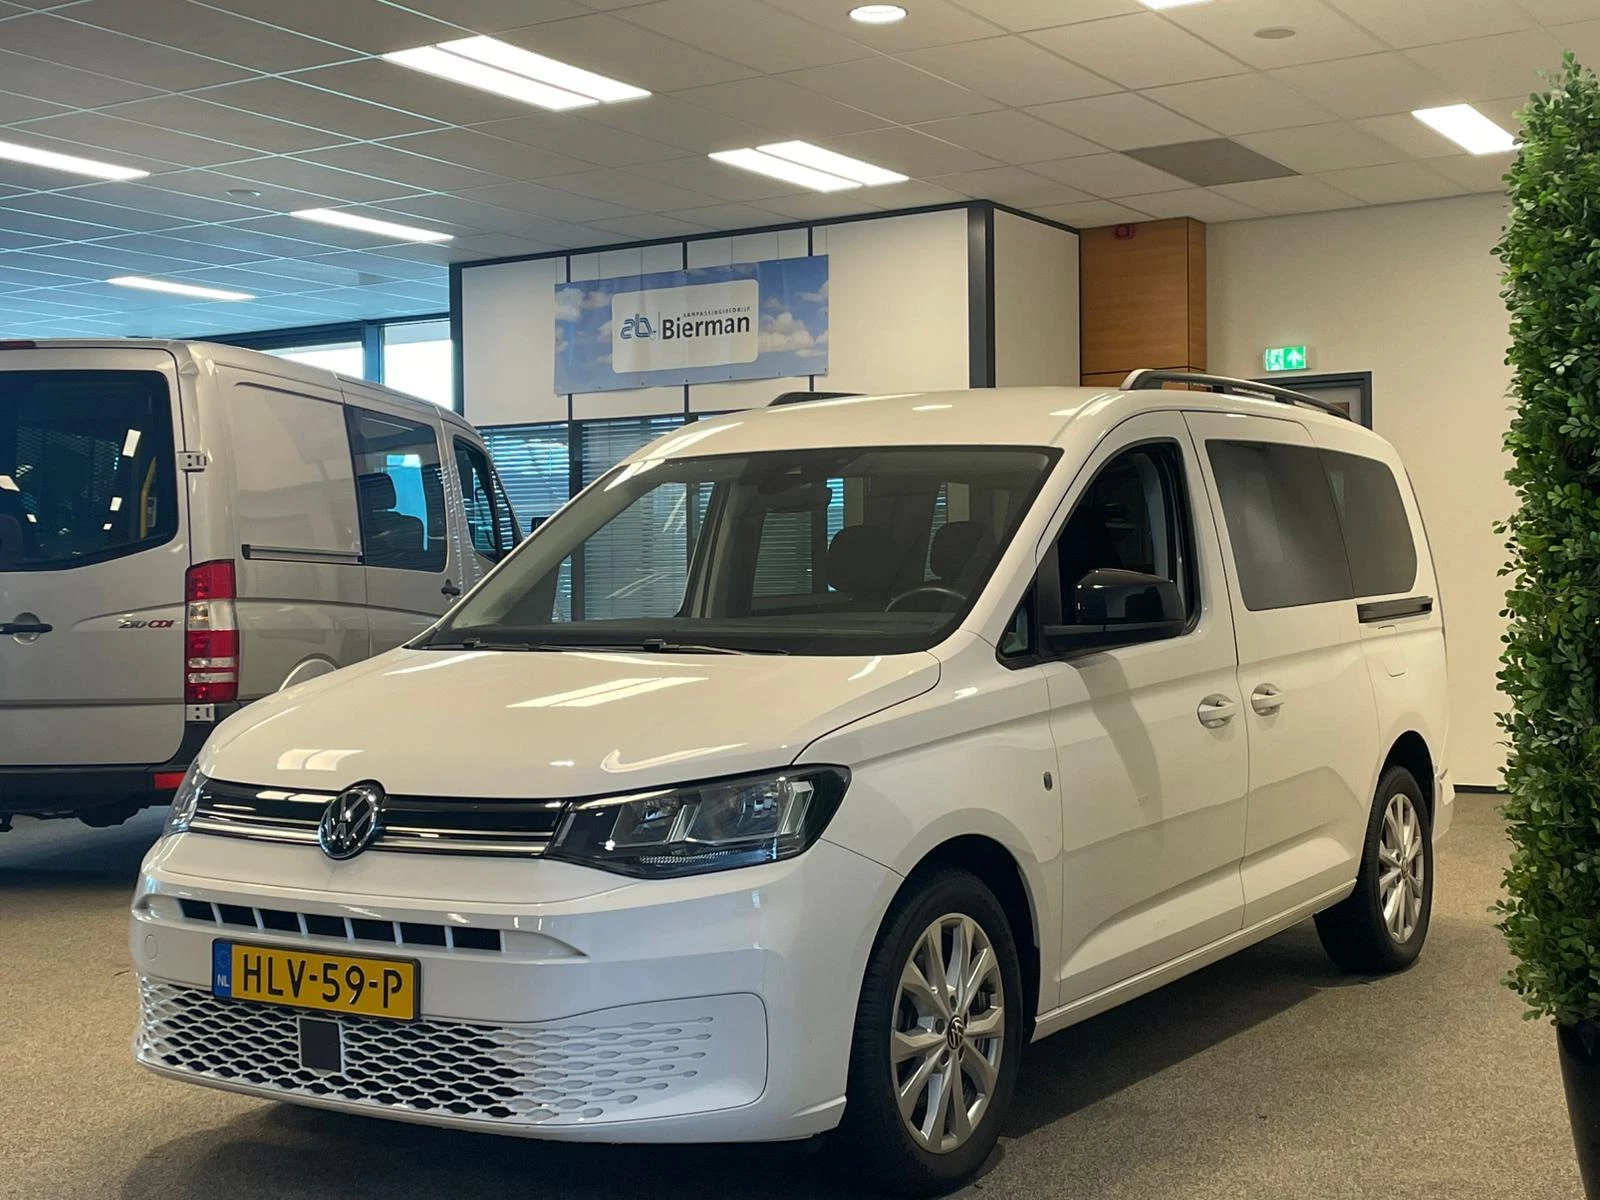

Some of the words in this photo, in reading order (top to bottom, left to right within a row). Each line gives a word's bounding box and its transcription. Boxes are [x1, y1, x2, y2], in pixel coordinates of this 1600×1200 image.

[662, 316, 750, 340] Bierman
[148, 619, 174, 628] CDI
[216, 974, 230, 988] NL
[243, 953, 403, 1009] HLV-59-P
